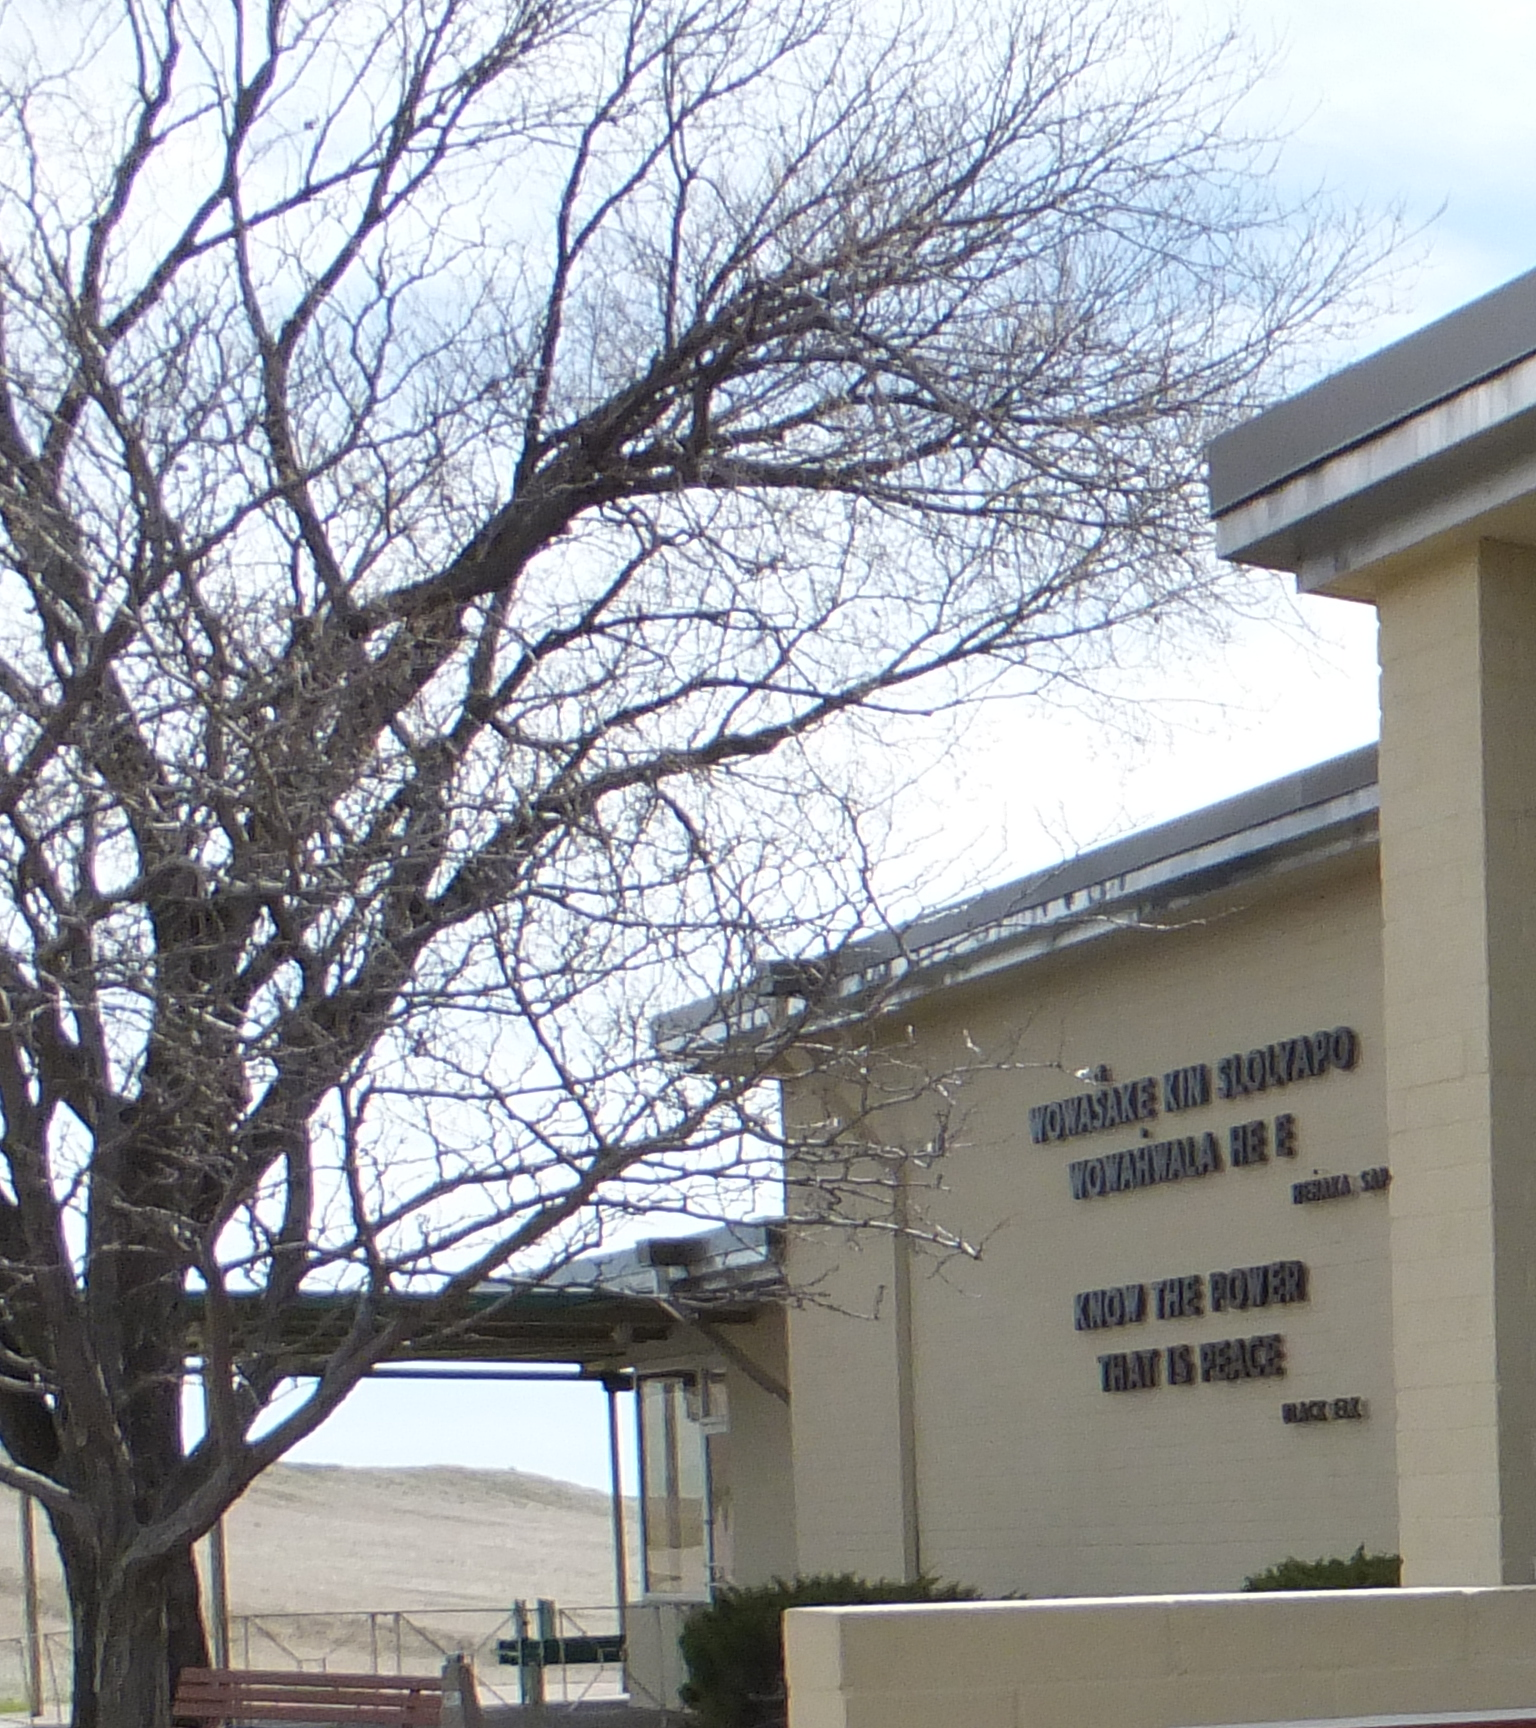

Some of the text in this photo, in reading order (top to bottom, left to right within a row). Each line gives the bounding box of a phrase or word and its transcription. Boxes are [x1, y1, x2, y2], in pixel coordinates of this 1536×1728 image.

[1164, 1064, 1210, 1112] KIN
[1217, 1026, 1357, 1099] SLOLYAPO
[1229, 1120, 1267, 1167] HE
[1275, 1113, 1297, 1158] E
[1074, 1260, 1308, 1332] KNOW THE POWER
[1098, 1334, 1286, 1392] THAT IS PEACE
